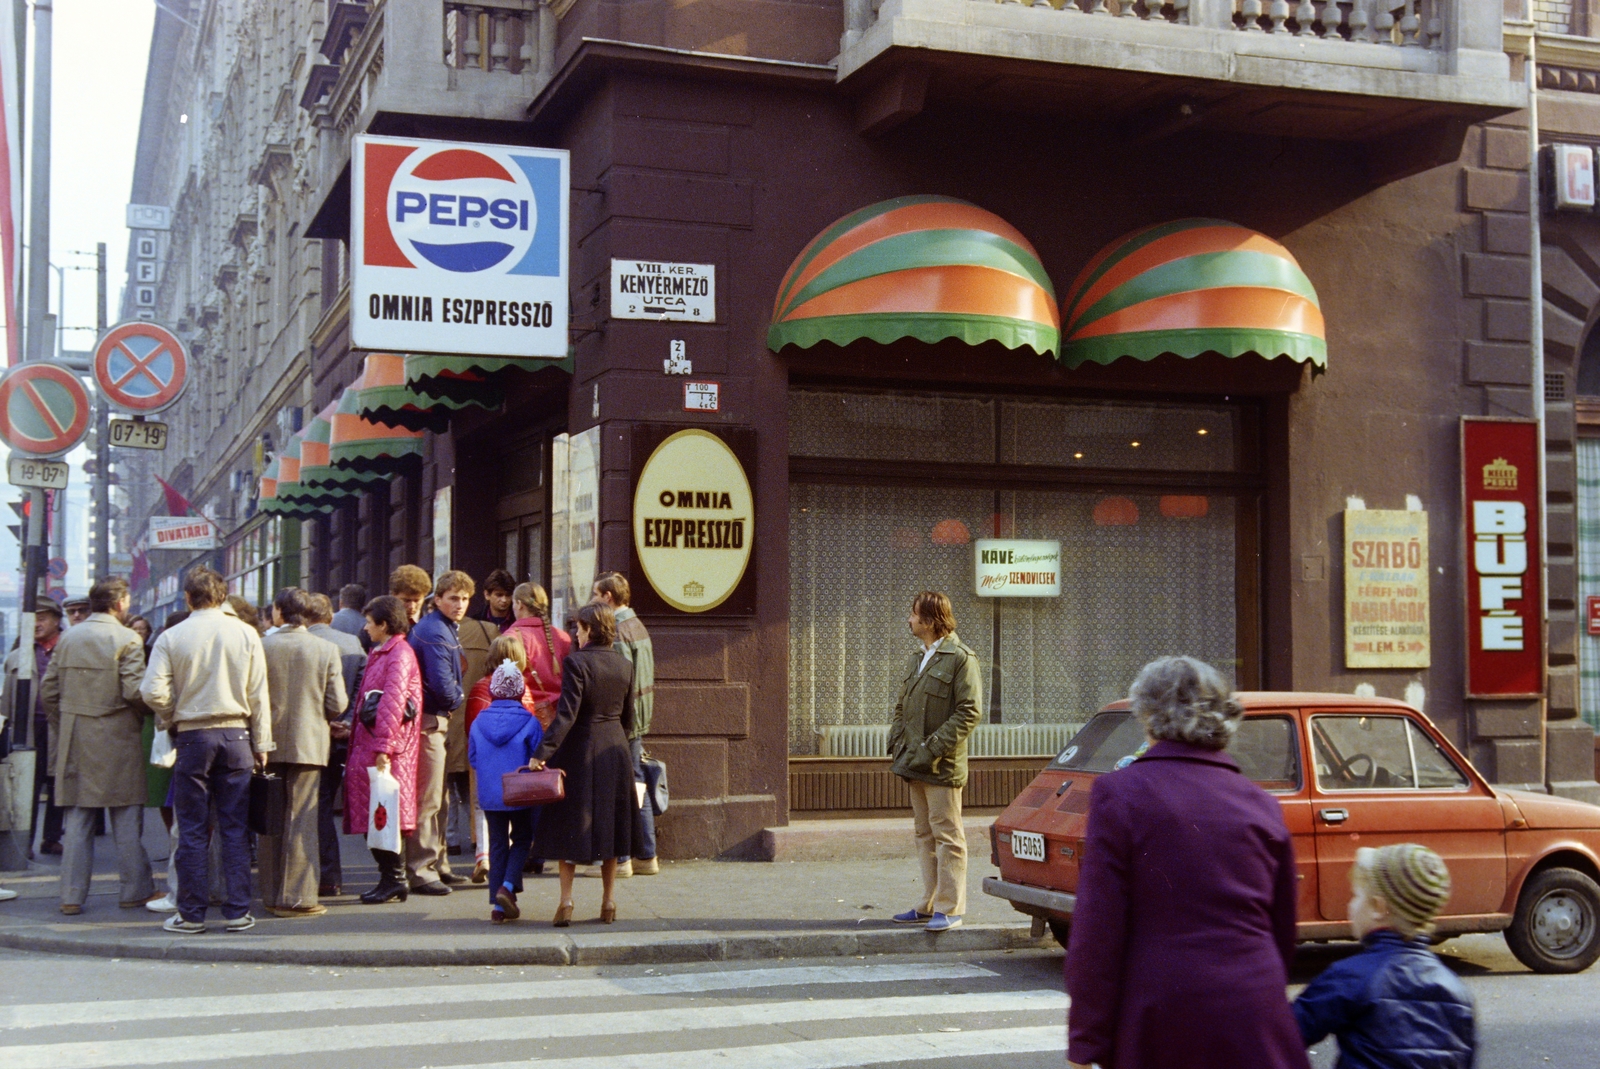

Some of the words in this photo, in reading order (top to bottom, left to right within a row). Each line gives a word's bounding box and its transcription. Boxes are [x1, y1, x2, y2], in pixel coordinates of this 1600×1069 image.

[396, 191, 529, 231] PEPSI
[636, 263, 665, 274] VIII.
[669, 266, 697, 275] KER.
[620, 273, 708, 297] KENYÉRMEZŐ
[369, 293, 433, 322] OMNIA
[442, 297, 553, 328] ESZPRESSZÓ
[629, 305, 636, 313] 2
[693, 308, 700, 316] 8
[643, 296, 687, 306] UTCA
[659, 490, 733, 509] OMNIA
[644, 517, 746, 549] ESZPRESSZÓ
[981, 548, 1015, 564] KÁVÉ
[1352, 537, 1421, 569] SZABÓ
[1009, 571, 1056, 585] SZENDVICSEK
[1473, 501, 1527, 650] BÜFÉ
